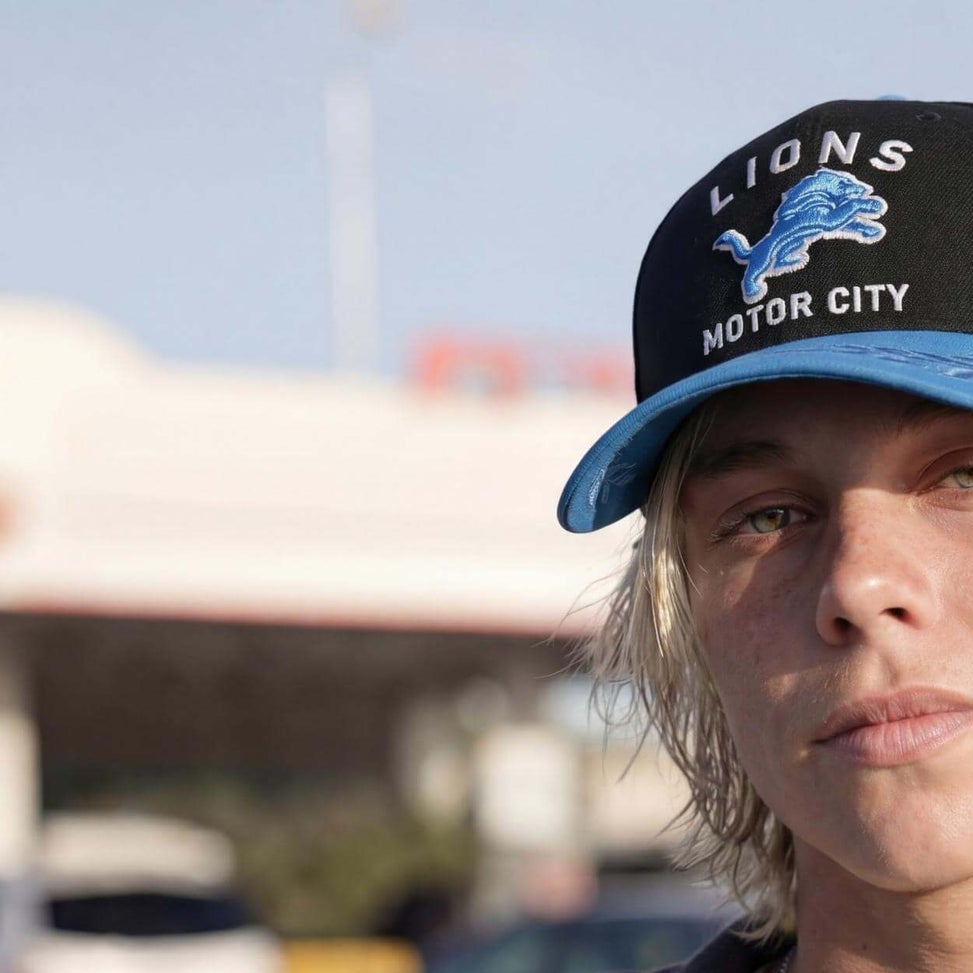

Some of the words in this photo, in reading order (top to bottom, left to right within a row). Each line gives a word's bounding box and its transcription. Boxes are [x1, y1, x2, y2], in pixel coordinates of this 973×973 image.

[710, 130, 914, 216] LIONS
[703, 291, 813, 356] MOTOR
[827, 283, 909, 315] CITY
